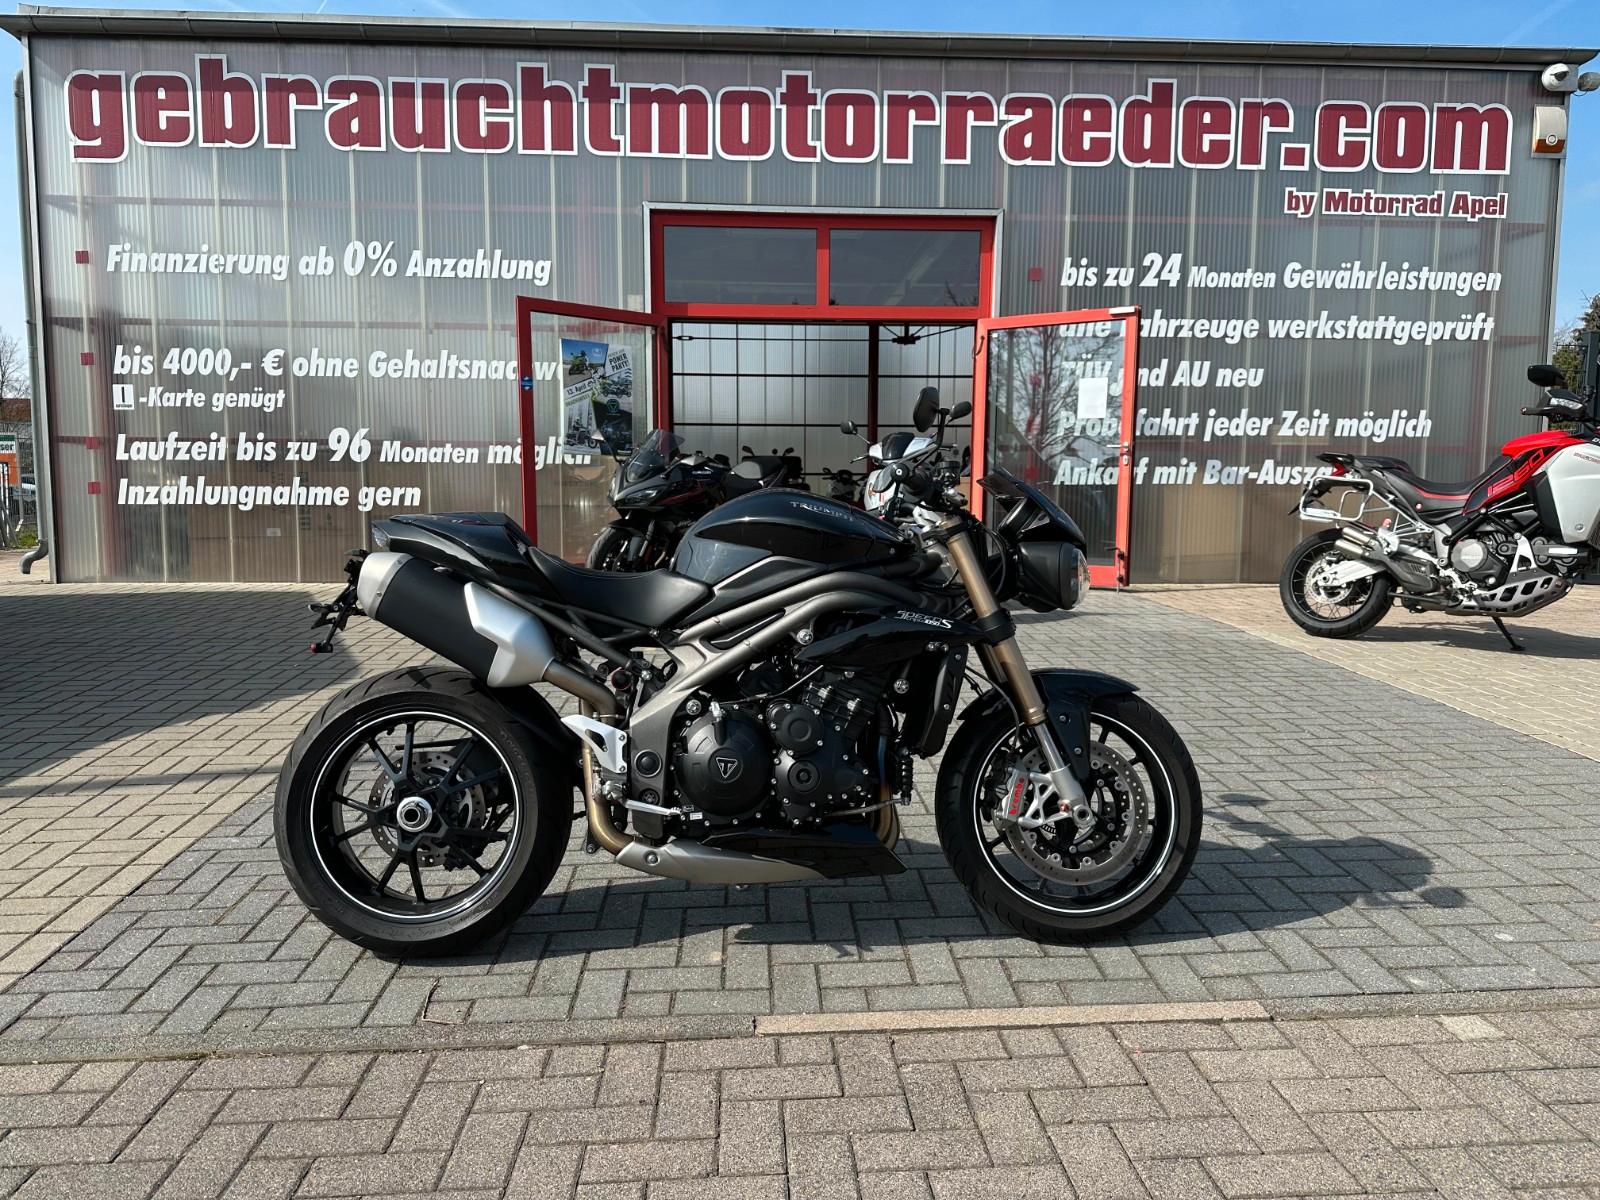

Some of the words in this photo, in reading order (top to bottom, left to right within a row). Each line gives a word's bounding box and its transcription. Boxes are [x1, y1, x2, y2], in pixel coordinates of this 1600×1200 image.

[65, 53, 1513, 176] gebrauchtmotorraeder.com
[1285, 188, 1317, 218] by
[1323, 188, 1445, 216] Motorrad
[1449, 190, 1508, 221] Apel
[107, 243, 289, 281] Finanzierung
[299, 246, 335, 276] ab
[344, 241, 397, 277] 0%
[406, 249, 551, 286] Anzahlung
[1061, 257, 1098, 287] bis
[1104, 267, 1135, 287] zu
[1140, 253, 1182, 287] 24
[1188, 266, 1276, 288] Monaten
[1283, 261, 1502, 297] Gewährleistungen
[1120, 309, 1260, 344] ahrzeuge
[1268, 311, 1495, 345] werkstattgeprüft
[113, 345, 154, 375] bis
[163, 348, 252, 382] 4000,-
[261, 349, 285, 376] €
[293, 348, 359, 378] ohne
[368, 350, 561, 381] Gehaltsnacw
[1171, 361, 1211, 387] AU
[1216, 369, 1264, 387] neu
[212, 387, 286, 412] genügt
[1056, 408, 1199, 437] Probfahrt
[1204, 409, 1274, 441] jeder
[1278, 409, 1330, 437] Zeit
[1334, 410, 1432, 442] möglich
[116, 432, 227, 461] Laufzeit
[236, 432, 277, 461] bis
[285, 441, 318, 462] zu
[328, 427, 371, 462] 96
[379, 441, 479, 464] Monaten
[1053, 457, 1149, 486] Ankaf
[1153, 458, 1199, 486] mit
[1203, 459, 1334, 486] Bar-Ausza
[1487, 449, 1544, 497] 1260
[118, 476, 350, 511] Inzahlungnahme
[358, 486, 421, 512] gern
